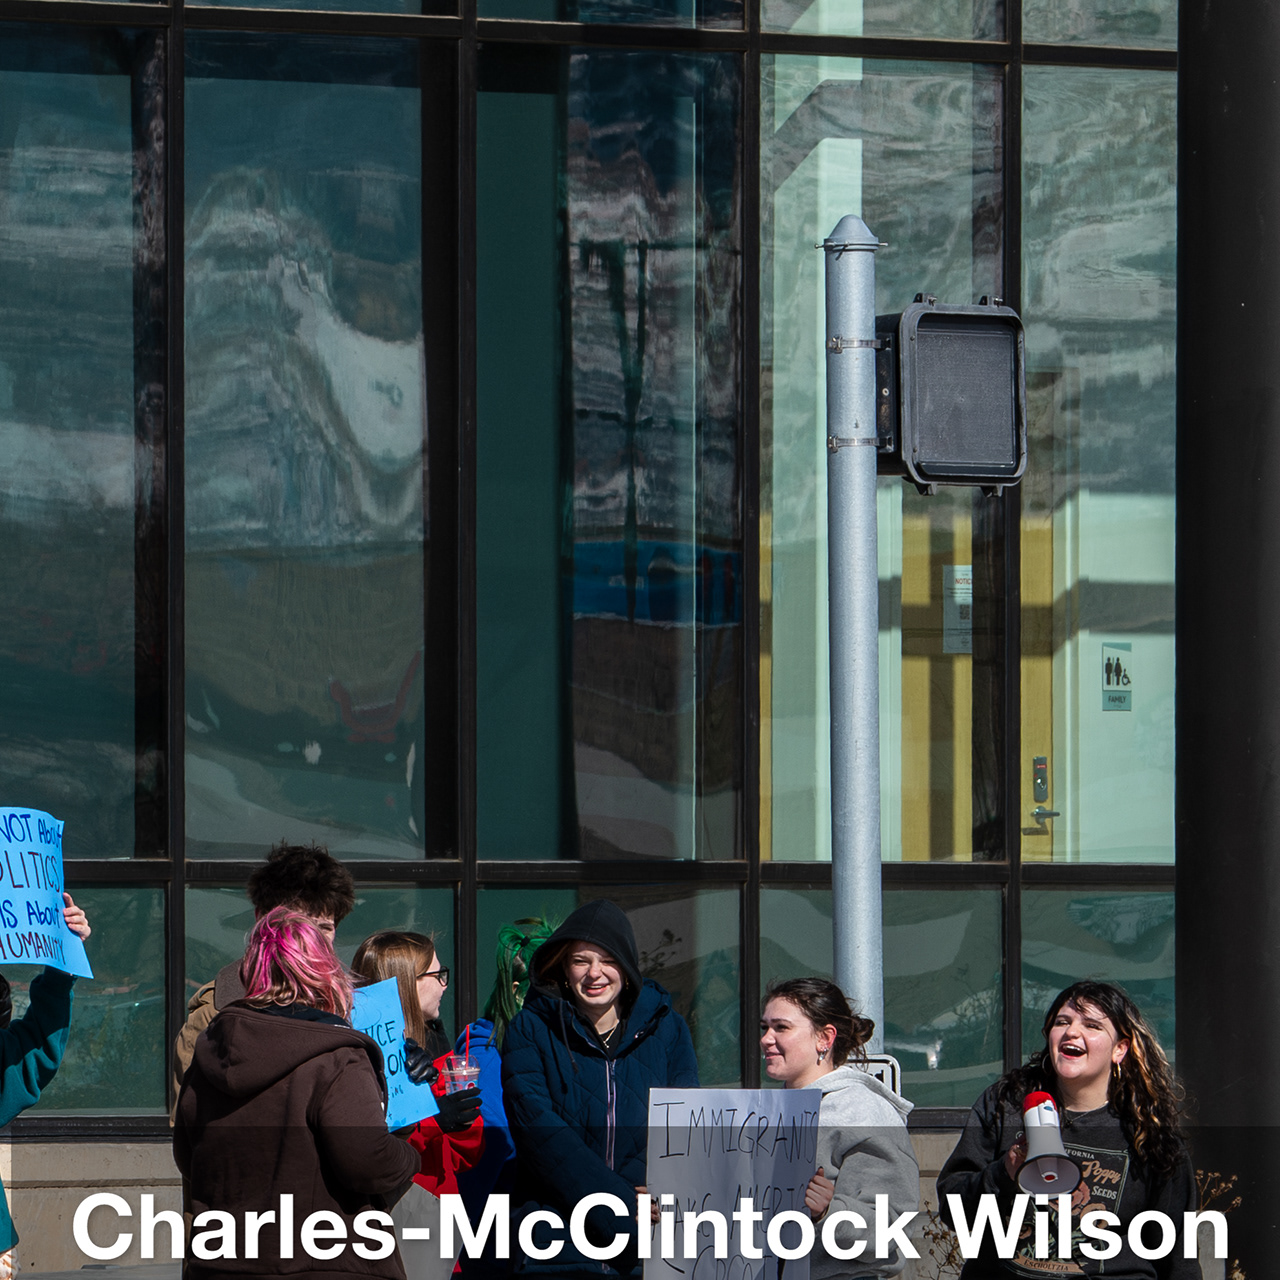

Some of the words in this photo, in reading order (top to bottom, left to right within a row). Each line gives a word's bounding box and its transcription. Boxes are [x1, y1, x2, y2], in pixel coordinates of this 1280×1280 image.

[1107, 694, 1127, 704] FAMILY
[653, 1101, 818, 1164] IMMIGRANTS
[1081, 1160, 1122, 1185] Poppy
